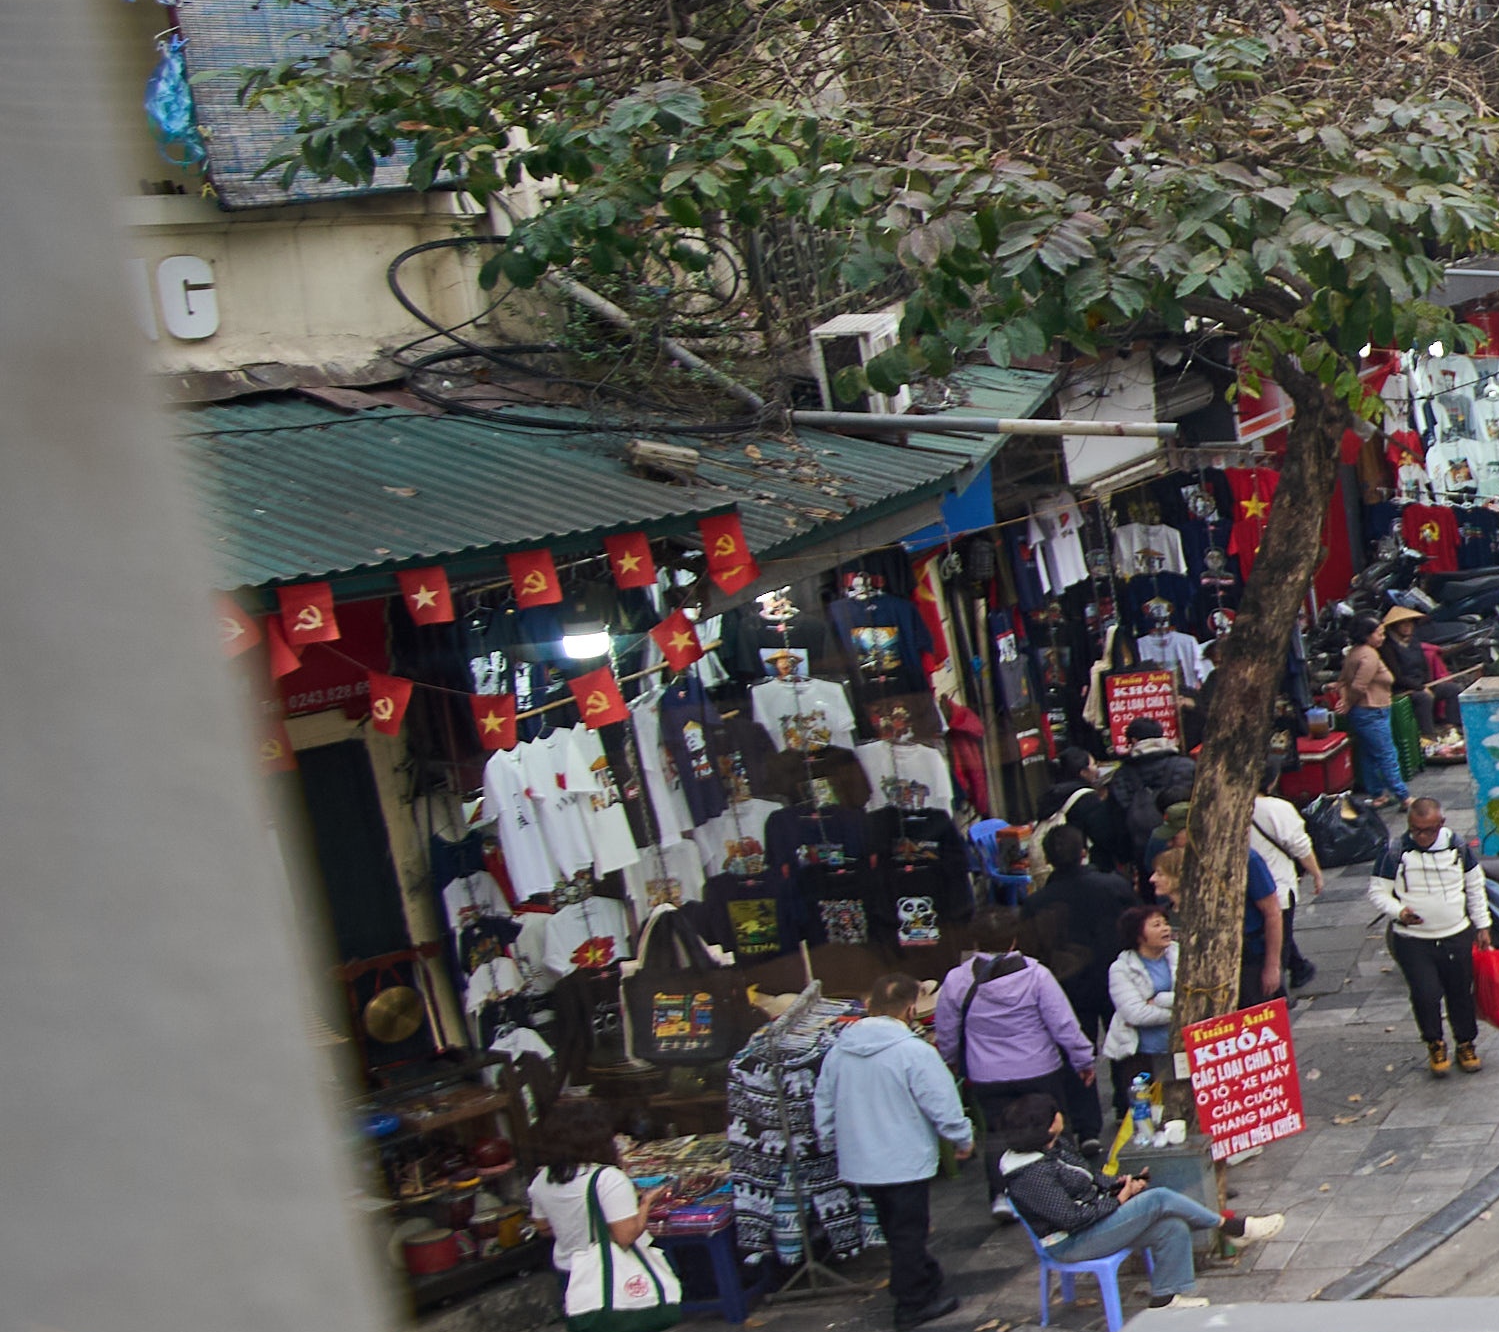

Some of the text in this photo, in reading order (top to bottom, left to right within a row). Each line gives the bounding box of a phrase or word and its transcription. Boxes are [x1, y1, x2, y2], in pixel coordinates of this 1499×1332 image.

[1113, 681, 1172, 698] KHÓA
[1190, 1019, 1236, 1043] Tuấn
[1193, 1025, 1280, 1067] KHÓA
[1191, 1067, 1217, 1090] CÁC
[1217, 1057, 1245, 1082] LOẠI
[1196, 1083, 1209, 1105] Ô
[1211, 1083, 1230, 1101] TÔ
[1241, 1074, 1260, 1091] XE
[1260, 1063, 1290, 1083] MÁY
[1210, 1098, 1290, 1136] THANG MÁY
[1211, 1084, 1283, 1119] CỬA CUỐN
[1210, 1138, 1231, 1161] HAY
